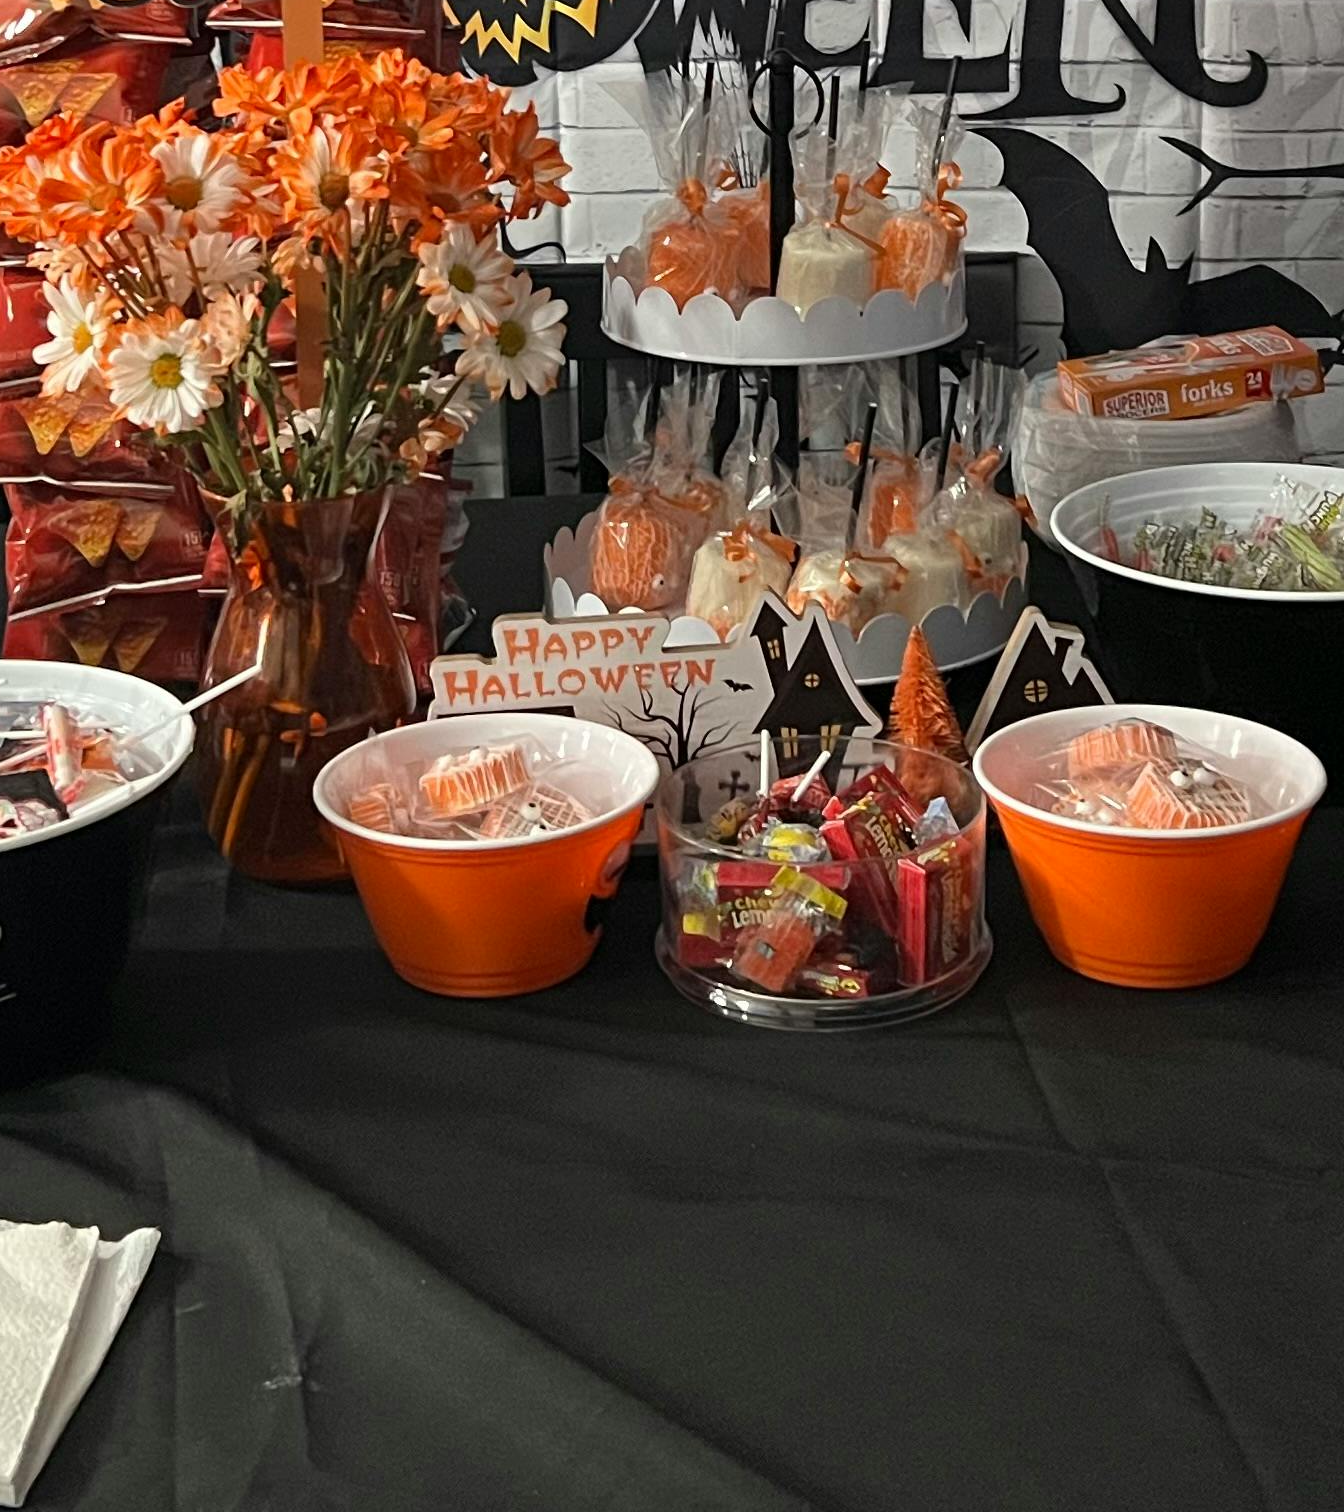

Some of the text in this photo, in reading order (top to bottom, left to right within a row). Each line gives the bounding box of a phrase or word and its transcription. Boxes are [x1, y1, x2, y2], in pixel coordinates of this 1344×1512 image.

[1106, 391, 1166, 415] SUPERIOR
[1181, 378, 1234, 404] forks
[504, 624, 657, 667] HAPPY
[442, 658, 717, 708] HALLOWEEN
